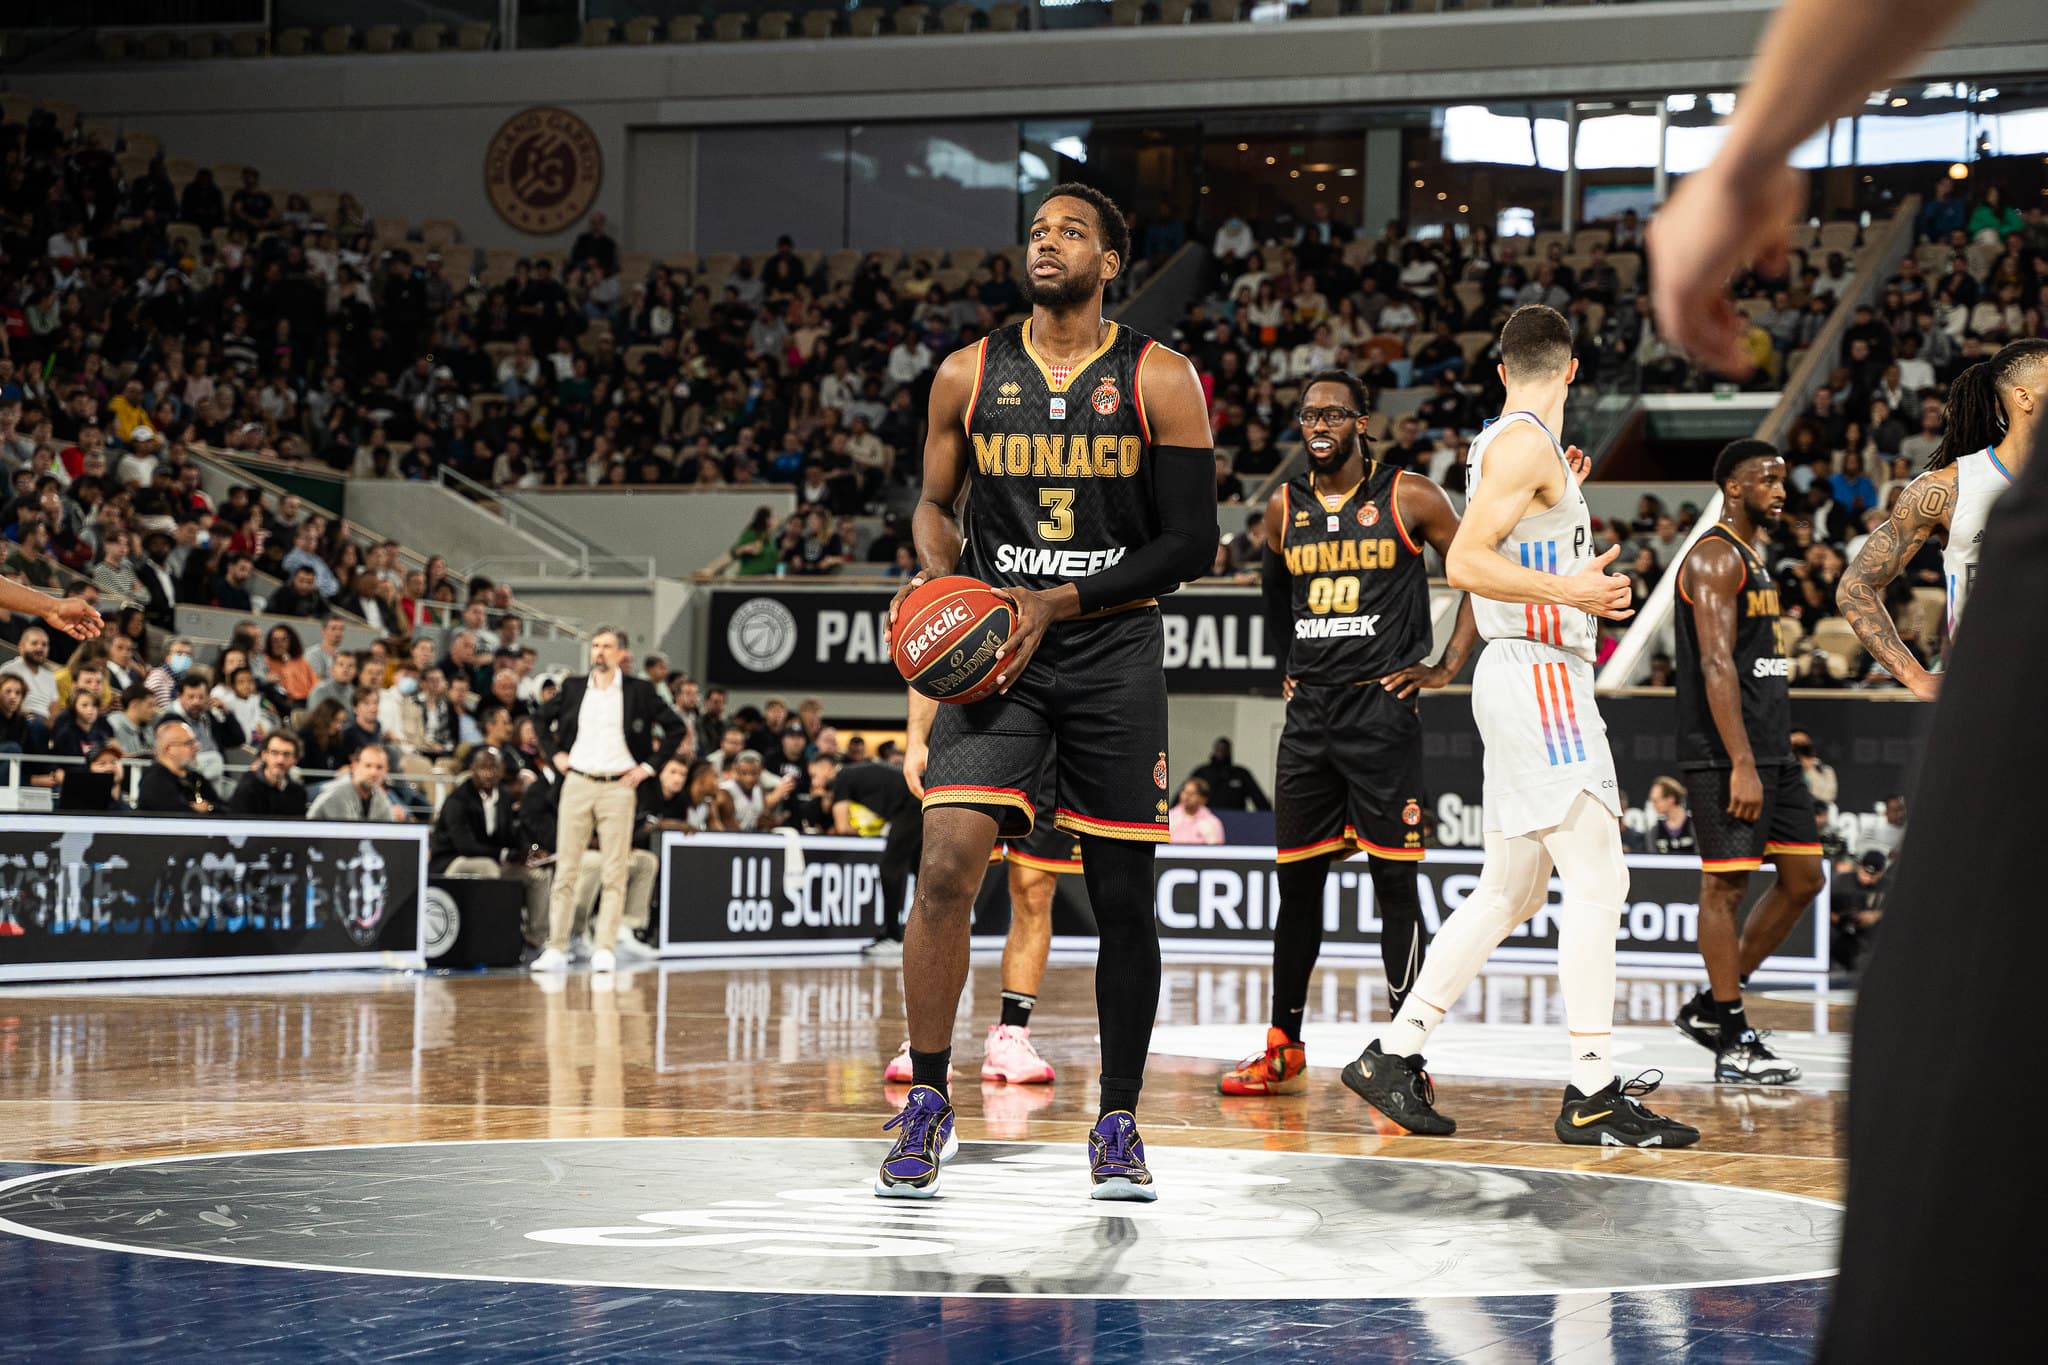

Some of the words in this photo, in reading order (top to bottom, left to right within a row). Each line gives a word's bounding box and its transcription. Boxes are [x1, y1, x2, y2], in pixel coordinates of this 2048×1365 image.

[972, 433, 1142, 478] MONACO
[1037, 487, 1075, 542] 3
[995, 544, 1126, 578] SKWEEK
[1284, 538, 1397, 576] MONACO
[1307, 575, 1361, 615] 00
[906, 604, 968, 662] Betclic
[1294, 614, 1381, 640] SKWEEK
[928, 629, 1002, 695] SPALDING
